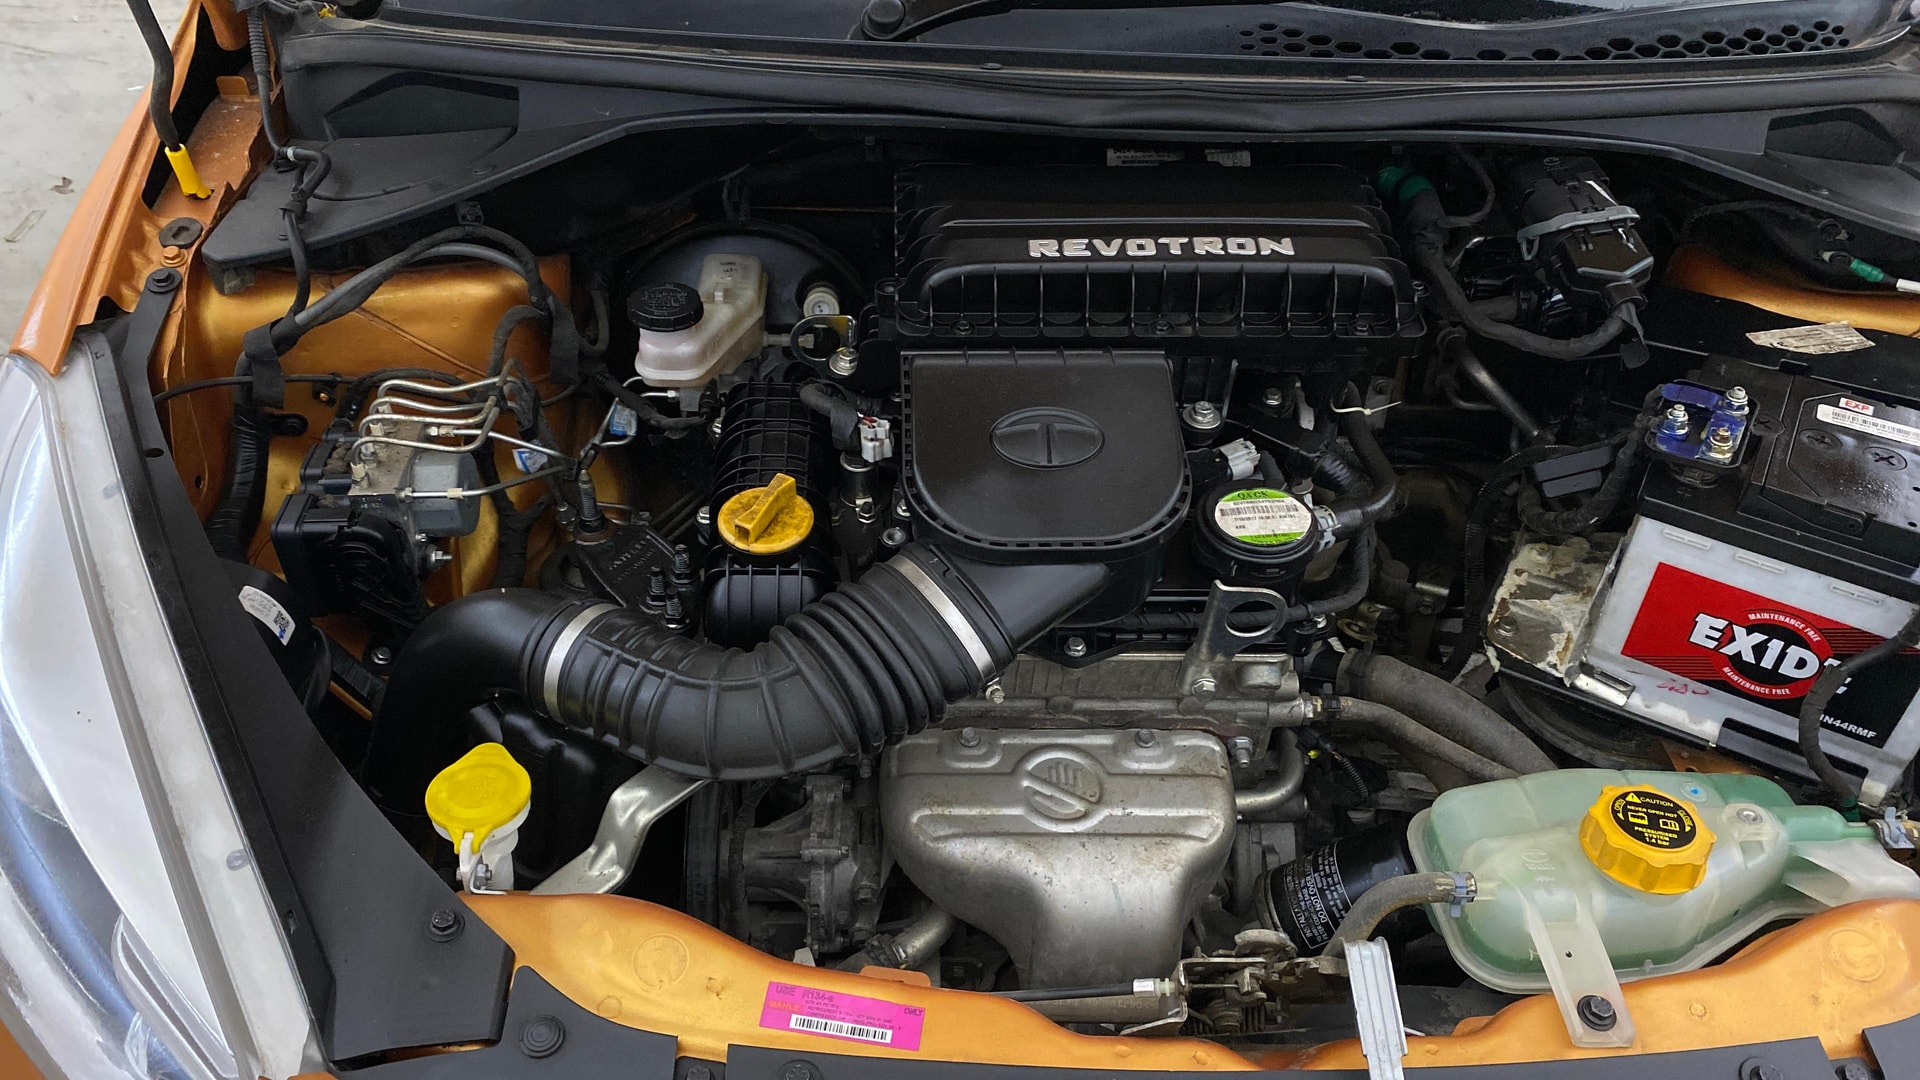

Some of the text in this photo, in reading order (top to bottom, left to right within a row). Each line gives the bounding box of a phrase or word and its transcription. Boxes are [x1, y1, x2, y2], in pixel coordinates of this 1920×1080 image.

[1027, 236, 1296, 258] REVOTRON
[1845, 400, 1869, 411] EXP
[1748, 612, 1822, 642] MAINTENANCE FREE
[1689, 613, 1852, 694] EXID
[1721, 666, 1771, 694] MAINTENANCE
[1772, 687, 1791, 695] FREE
[1819, 713, 1878, 738] IN44RMF
[1640, 797, 1673, 807] CAUTION
[1634, 826, 1678, 838] PRESSURISED
[1644, 832, 1670, 841] SYSTEM
[1305, 875, 1316, 895] OVER
[1310, 895, 1322, 911] NOT
[1317, 911, 1328, 923] DO
[768, 1000, 802, 1012] MAHLE
[776, 984, 796, 996] USE
[903, 1007, 924, 1017] ONLY
